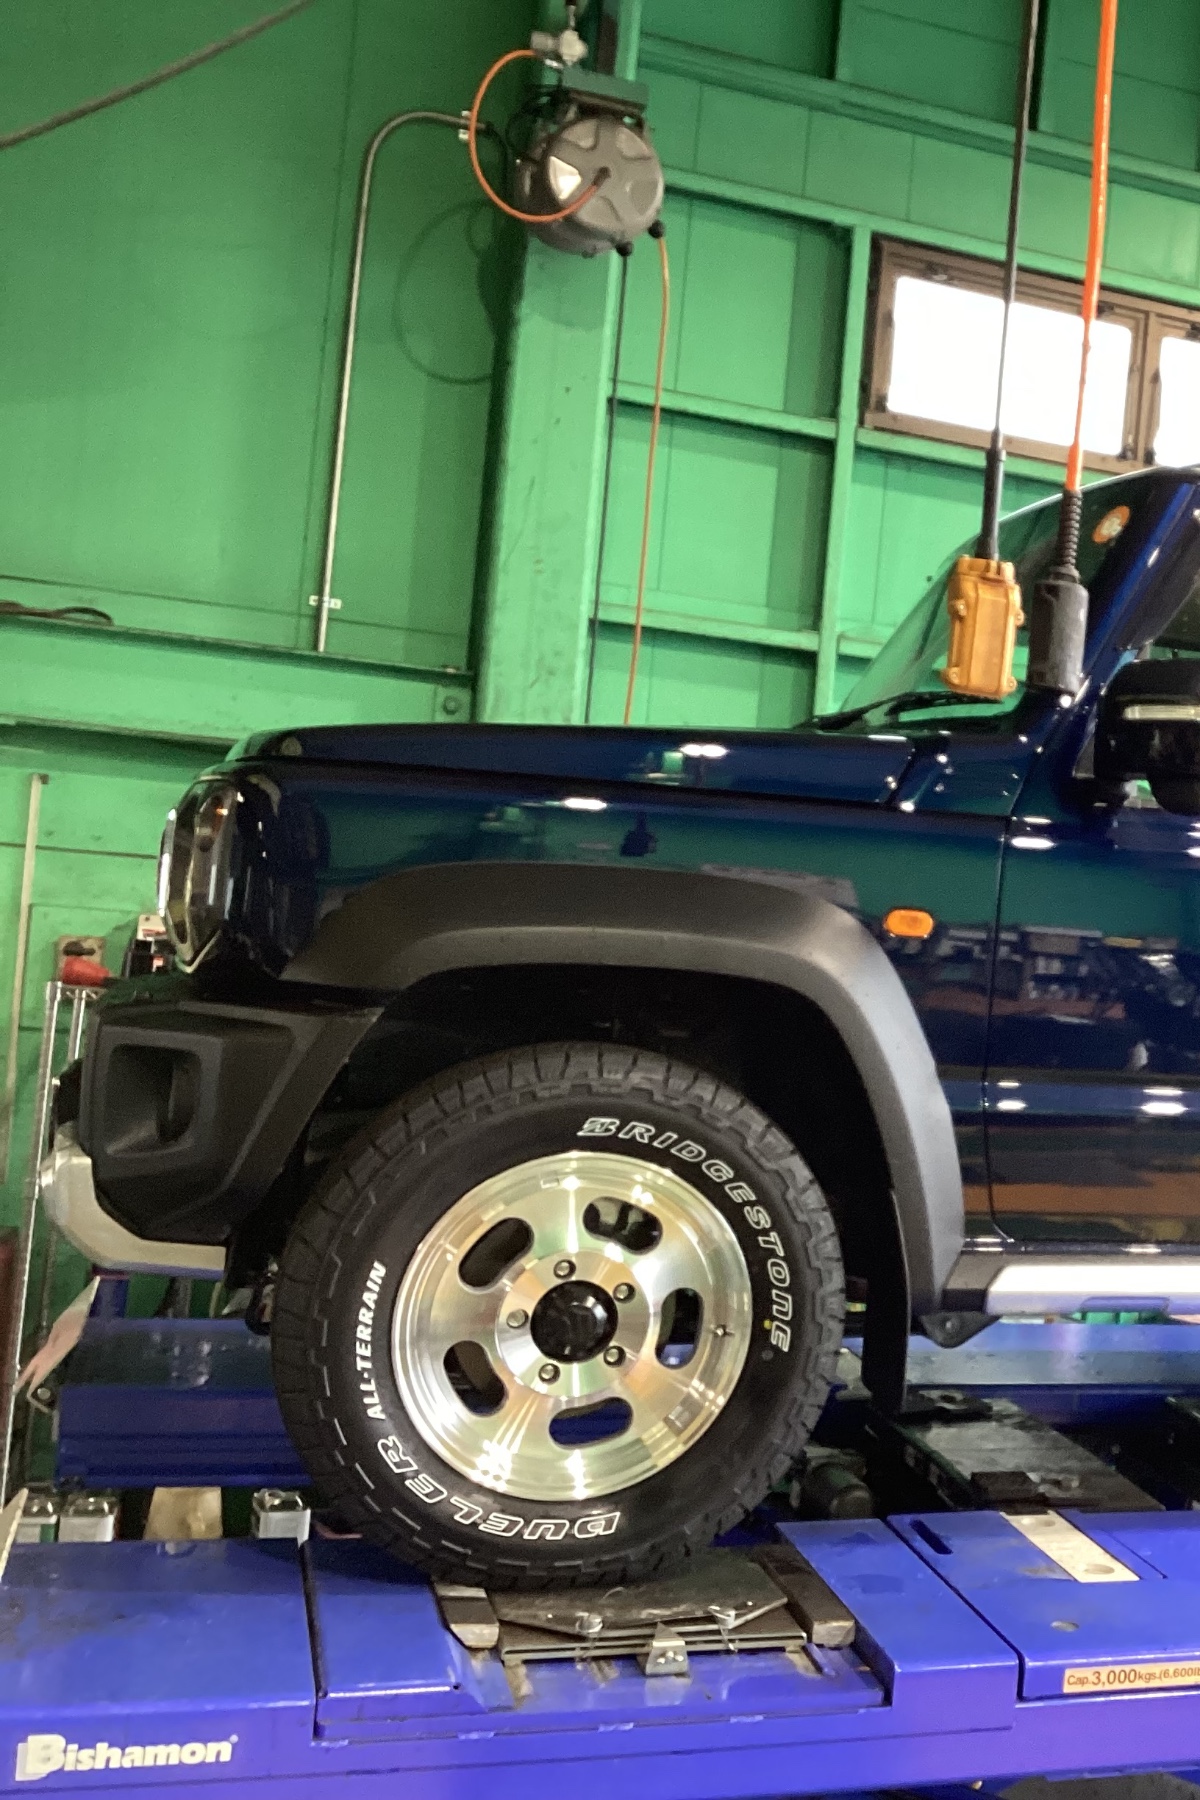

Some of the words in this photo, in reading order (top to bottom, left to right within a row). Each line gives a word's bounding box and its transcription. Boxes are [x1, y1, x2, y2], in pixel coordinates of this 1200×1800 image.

[577, 1117, 793, 1353] BRIDGESTONE
[355, 1259, 388, 1421] ALL-TERRAIN
[377, 1434, 621, 1541] DUELER
[15, 1734, 233, 1782] Bishamon
